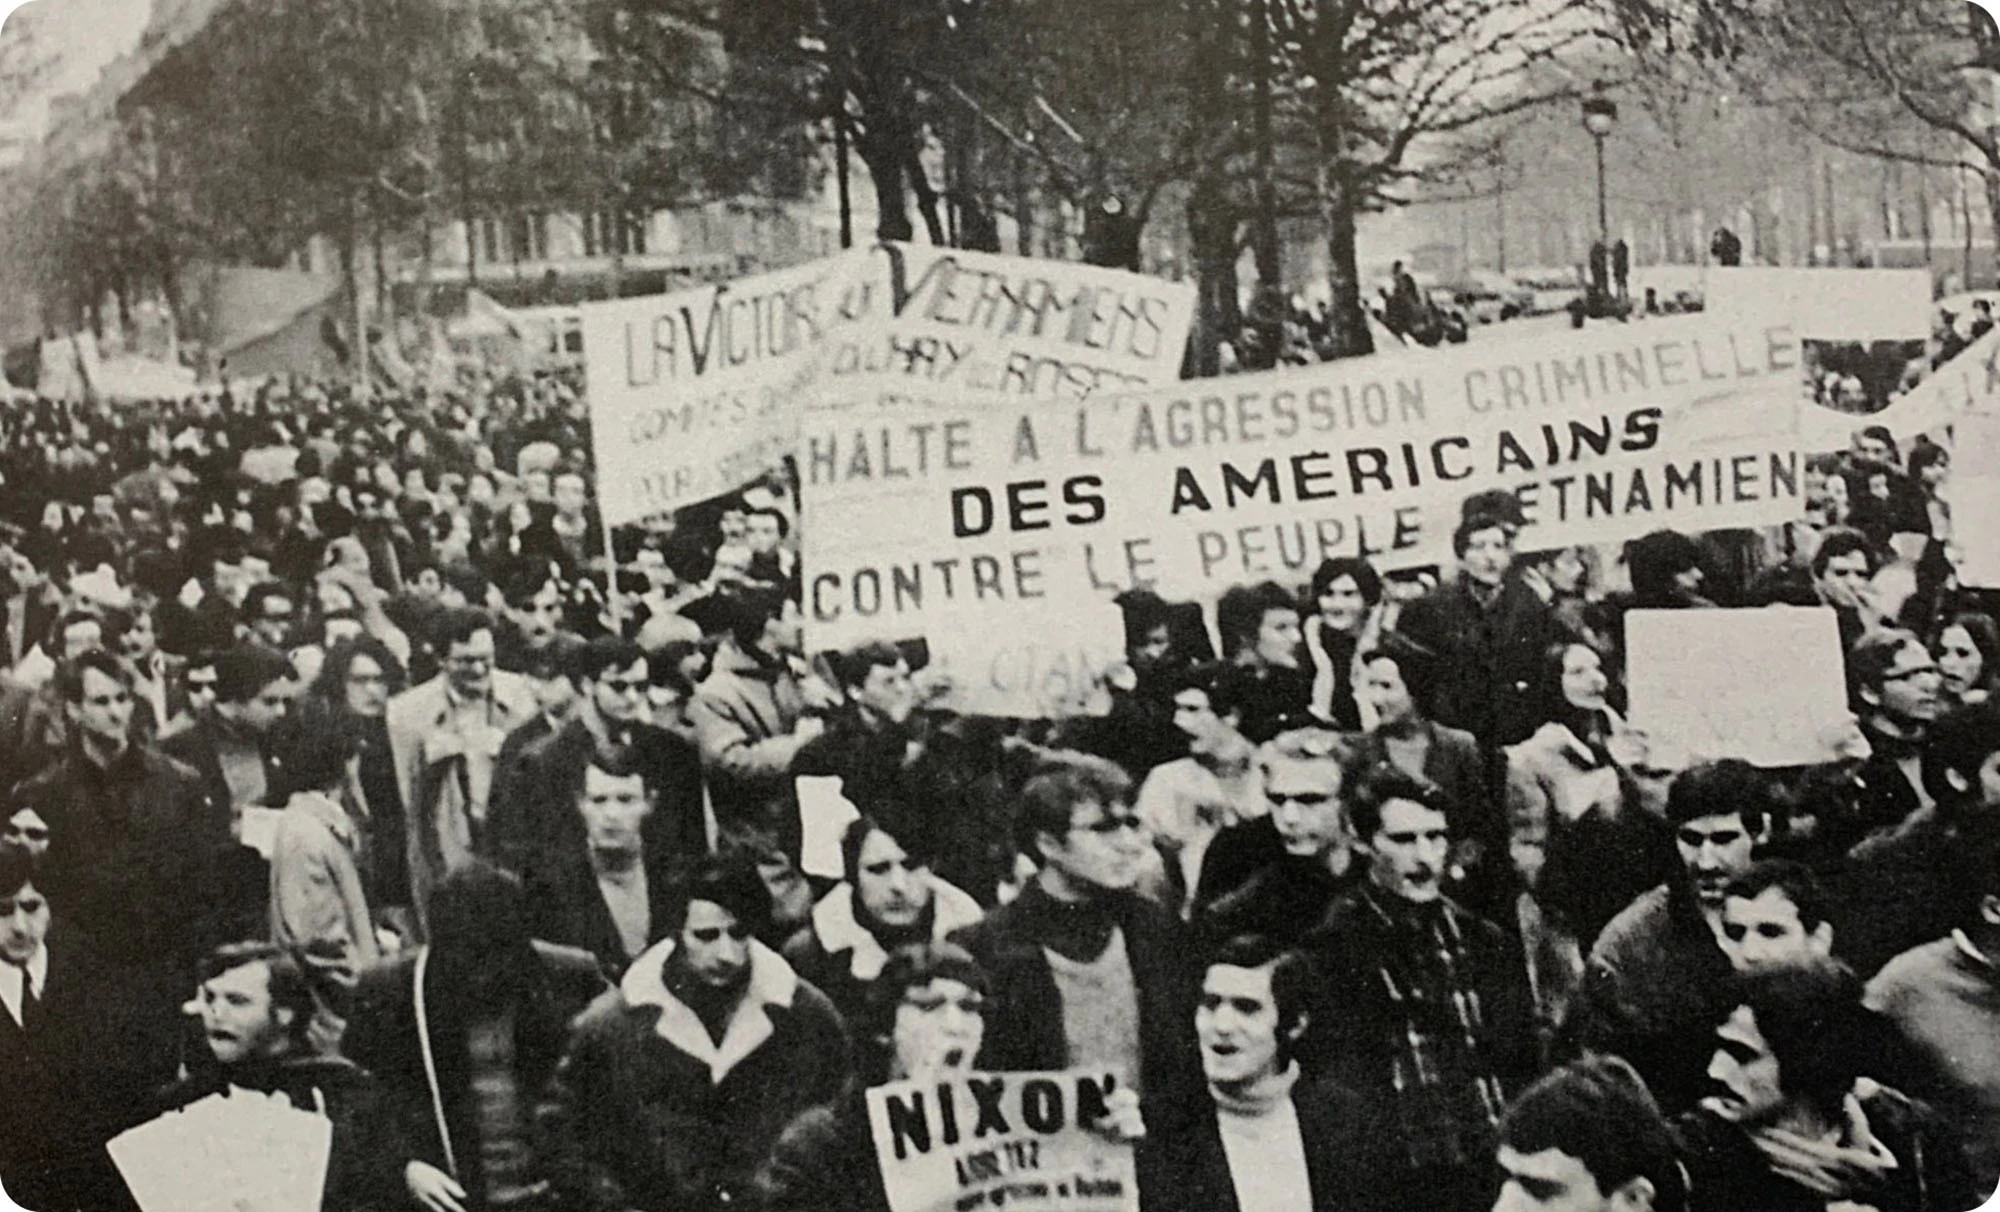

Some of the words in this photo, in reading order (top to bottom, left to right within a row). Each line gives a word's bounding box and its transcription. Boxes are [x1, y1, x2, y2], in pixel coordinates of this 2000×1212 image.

[808, 418, 972, 484] HALTE
[1075, 384, 1426, 457] L'AGRESSION
[1464, 325, 1797, 415] CRIMINELLE
[813, 548, 1046, 622] CONTRE
[1085, 537, 1158, 592] LE
[1199, 508, 1422, 577] PEUPLE
[1515, 451, 1798, 525] ETNAMIEN
[951, 475, 1106, 538] DES
[886, 1073, 1116, 1160] NIXON
